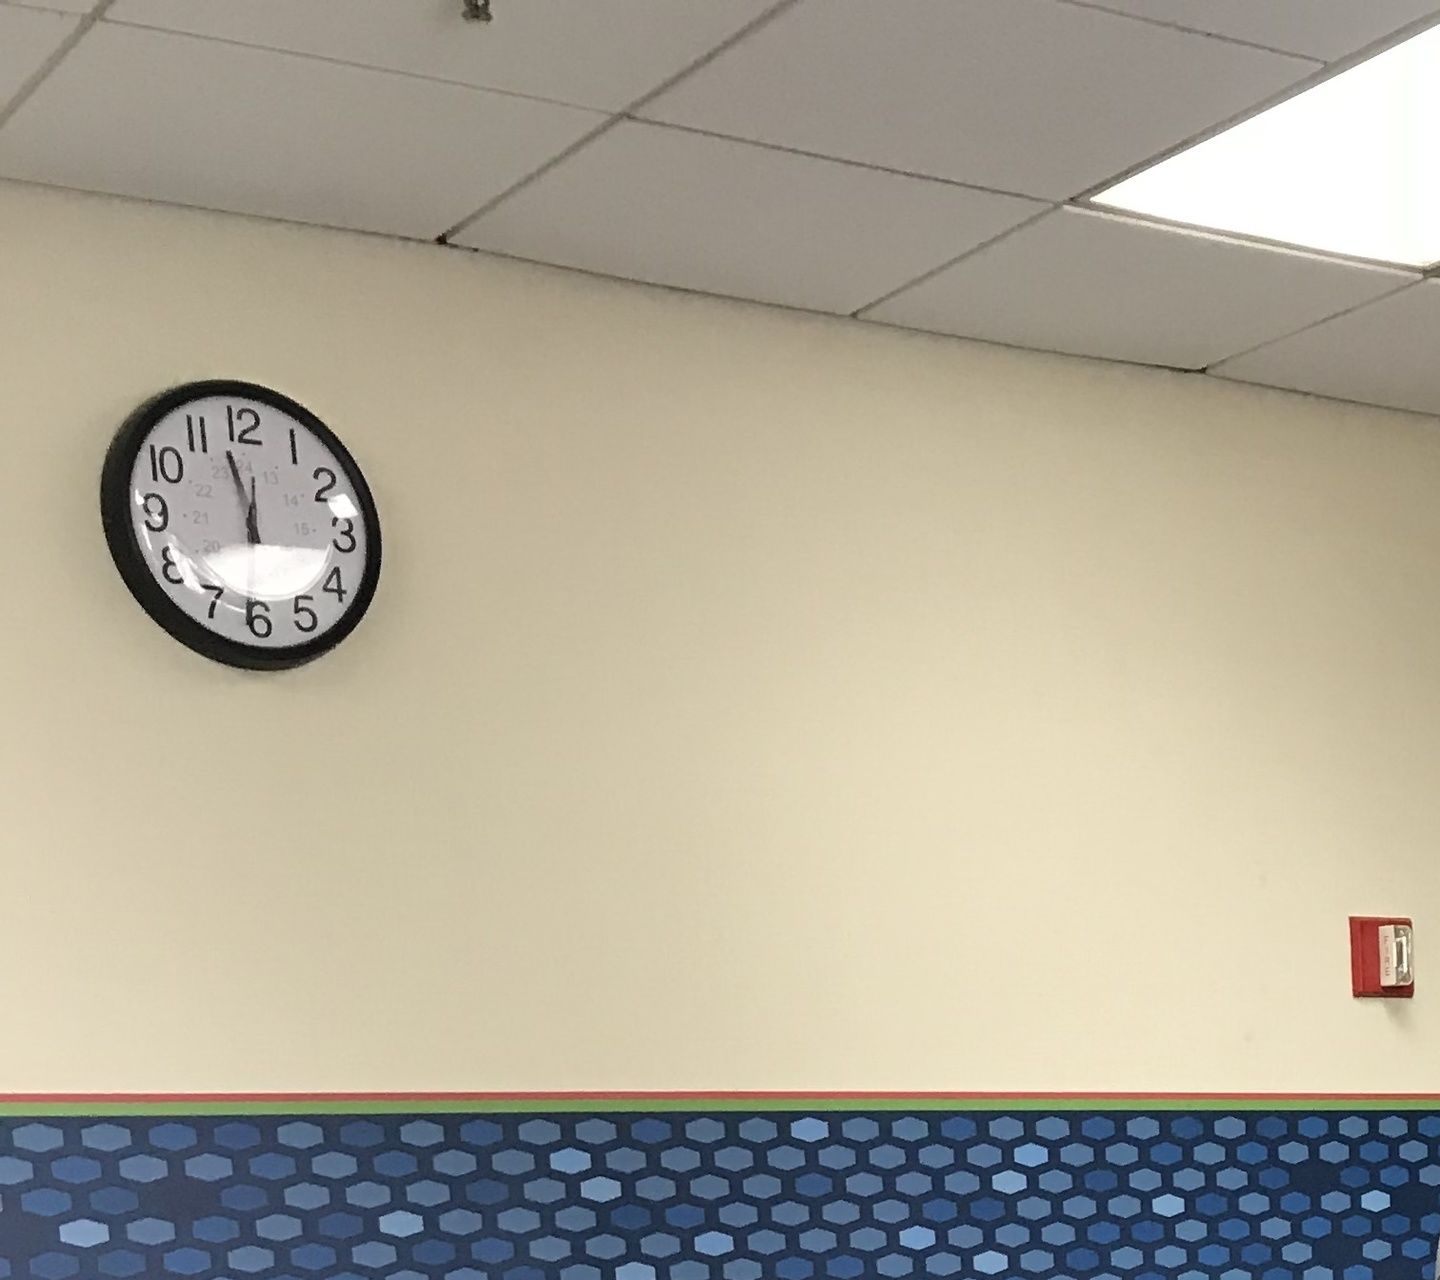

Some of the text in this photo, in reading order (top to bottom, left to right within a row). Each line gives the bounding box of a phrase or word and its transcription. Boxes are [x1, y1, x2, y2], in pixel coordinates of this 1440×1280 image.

[186, 414, 208, 453] 11
[226, 405, 263, 446] 12
[149, 444, 184, 484] 10
[289, 427, 298, 465] 1
[312, 467, 337, 502] 2
[142, 493, 169, 532] 9
[331, 516, 357, 553] 3
[162, 545, 185, 585] 8
[200, 584, 224, 619] 7
[322, 566, 347, 603] 4
[249, 599, 272, 639] 6
[293, 595, 318, 633] 5
